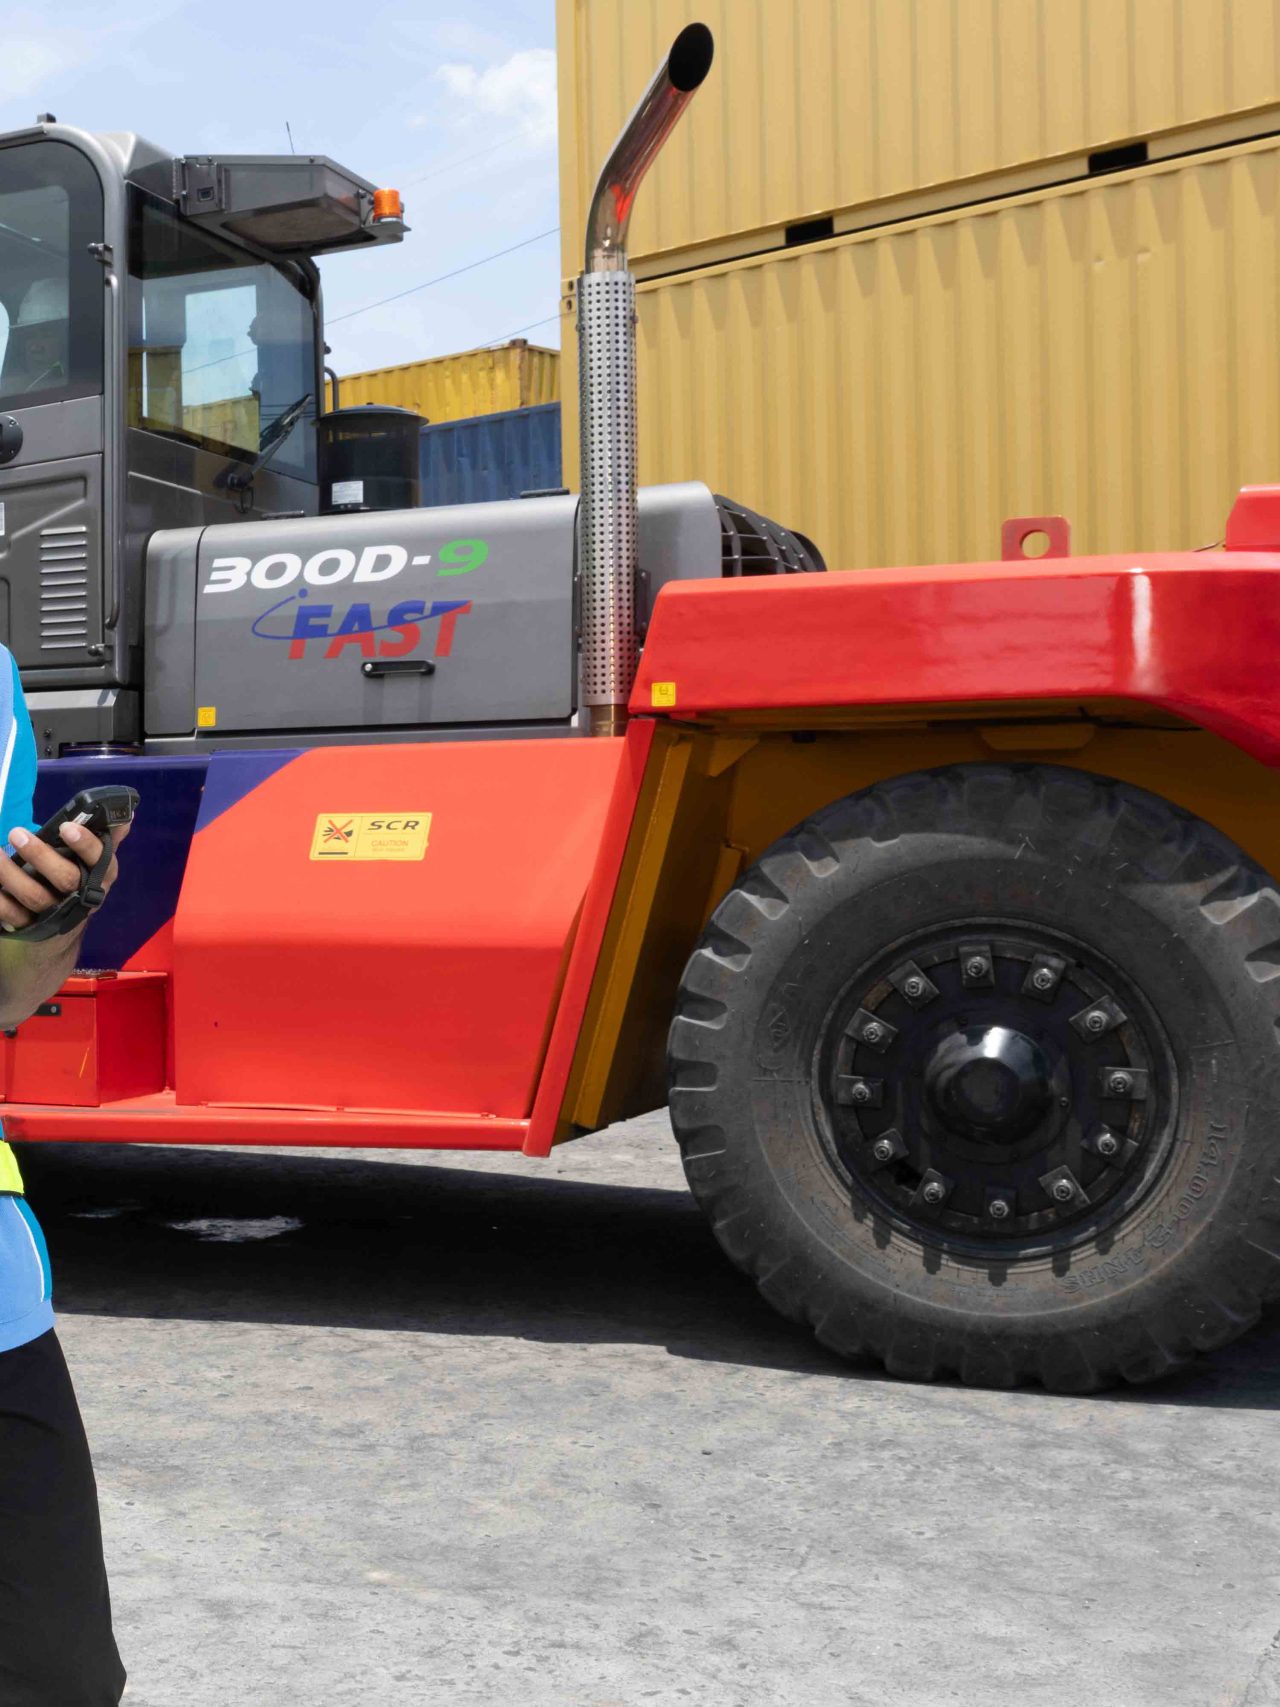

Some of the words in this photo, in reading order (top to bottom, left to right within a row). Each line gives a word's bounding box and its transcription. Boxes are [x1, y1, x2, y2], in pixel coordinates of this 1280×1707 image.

[202, 538, 489, 593] 300D-9
[367, 820, 421, 831] SCR
[371, 839, 409, 847] CAUTION
